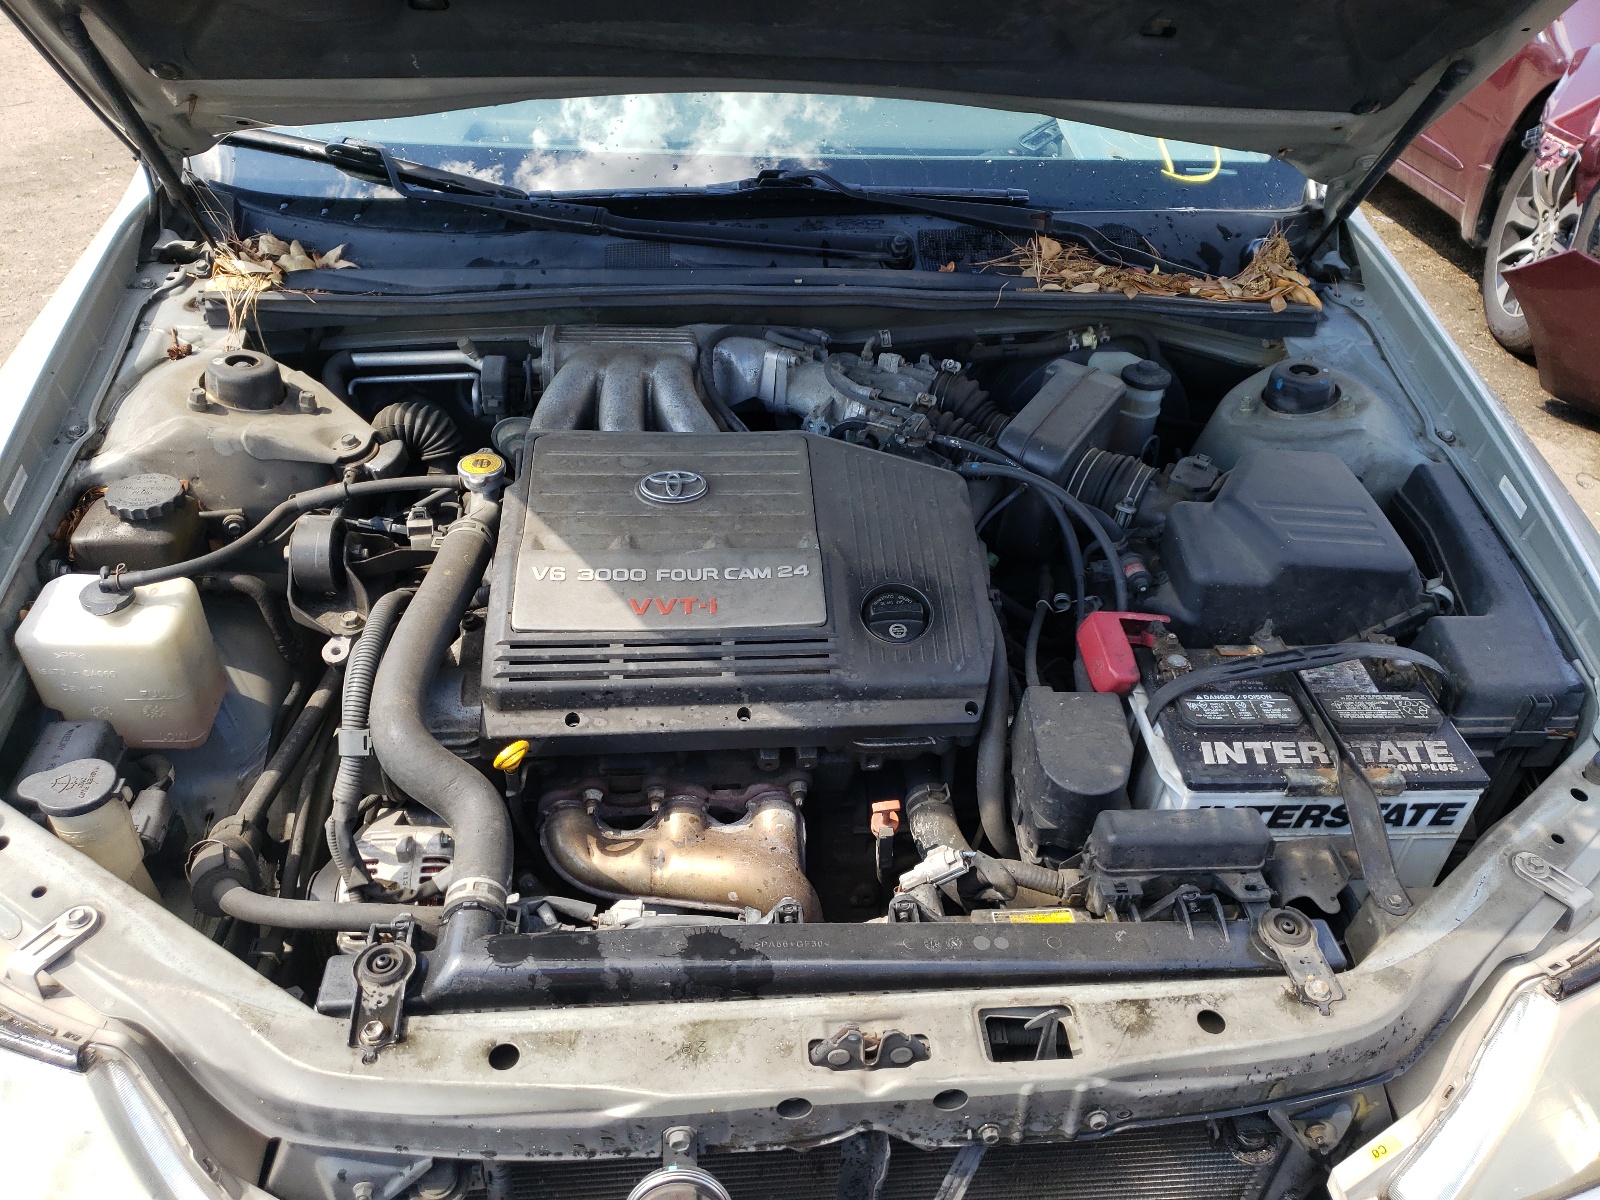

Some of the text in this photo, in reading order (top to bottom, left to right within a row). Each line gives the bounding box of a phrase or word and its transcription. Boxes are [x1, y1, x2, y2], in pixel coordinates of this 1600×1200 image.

[531, 564, 810, 582] V6 3000 FOUR CAM 24
[628, 597, 718, 616] VVT-i
[1200, 740, 1455, 764] INTERTATE
[1421, 763, 1459, 772] PLUS
[1199, 803, 1467, 828] ERSATE
